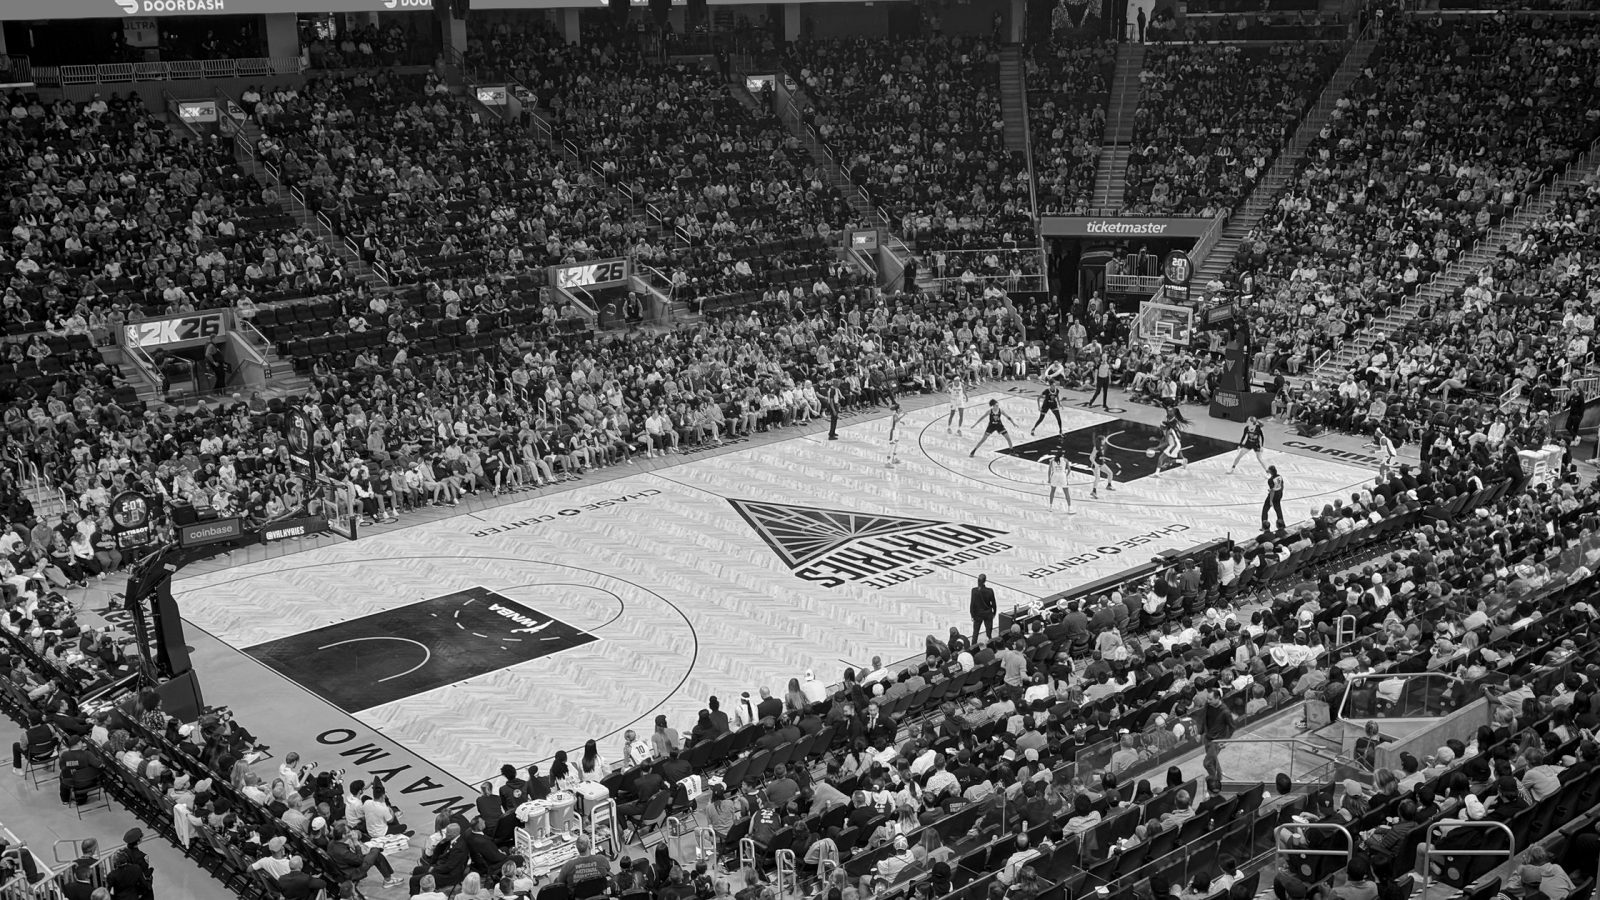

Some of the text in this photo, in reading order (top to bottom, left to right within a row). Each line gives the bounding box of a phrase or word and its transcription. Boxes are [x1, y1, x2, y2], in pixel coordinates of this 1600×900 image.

[144, 0, 224, 11] DOORDASH
[1086, 221, 1167, 234] ticketmaster
[565, 262, 622, 287] 2K26
[138, 313, 219, 345] 2K26
[470, 488, 662, 538] CENTER CHASE
[190, 525, 233, 540] coinbase
[266, 526, 304, 541] @VALKYRIES
[795, 523, 1010, 588] VALKYRIES
[1019, 522, 1190, 580] CENTER CHASE
[861, 541, 1013, 591] STATE GOLDEN
[488, 603, 538, 628] WNBA
[636, 745, 646, 754] 10
[313, 729, 475, 815] WAYMO
